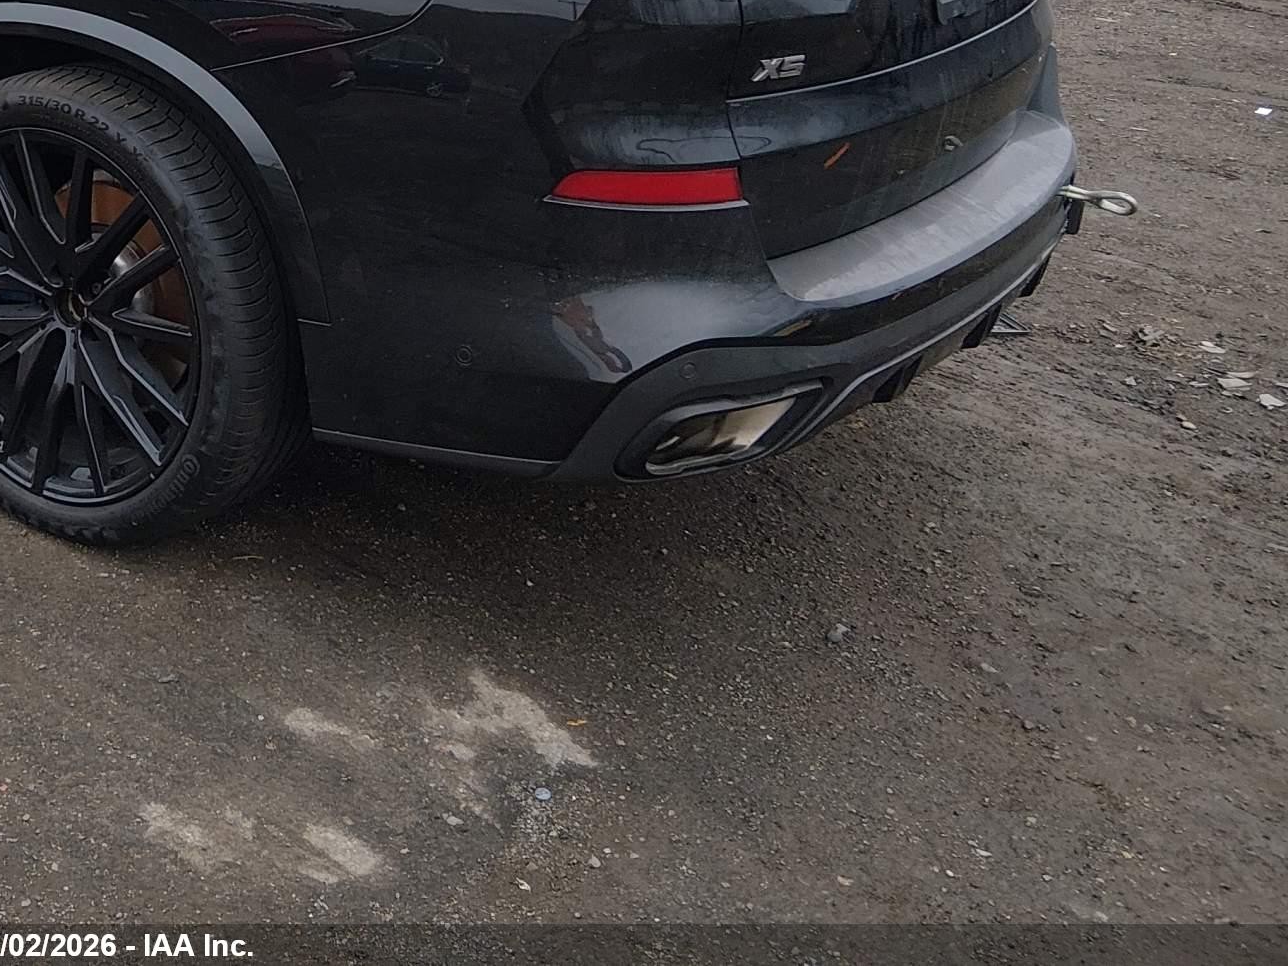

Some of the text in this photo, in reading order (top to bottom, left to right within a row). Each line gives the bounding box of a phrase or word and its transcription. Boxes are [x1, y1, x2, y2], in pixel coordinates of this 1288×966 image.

[752, 54, 806, 82] X5
[16, 95, 110, 131] 315/30 R 22
